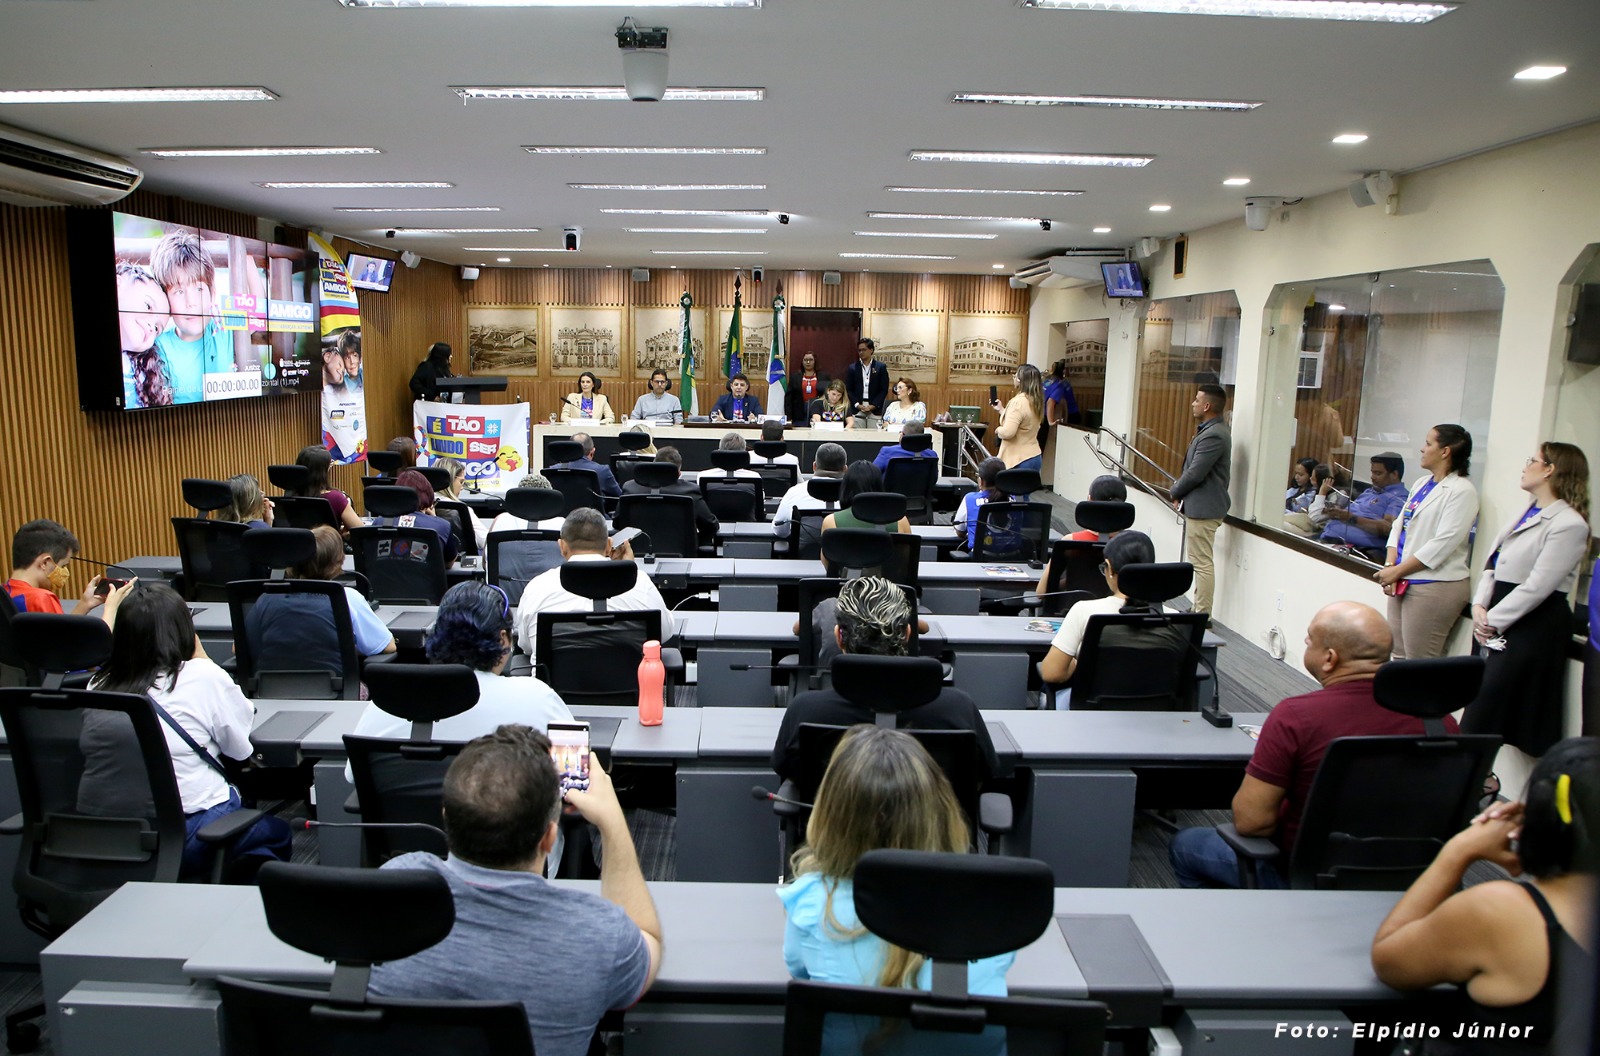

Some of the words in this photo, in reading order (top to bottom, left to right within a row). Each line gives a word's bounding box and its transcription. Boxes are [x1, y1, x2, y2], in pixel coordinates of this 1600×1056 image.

[324, 282, 347, 293] AMIGO
[235, 293, 254, 307] TÃO
[270, 303, 311, 319] AMIGO
[207, 378, 258, 394] 00:00:00.00
[433, 418, 442, 433] É
[448, 415, 480, 432] TÃO
[431, 439, 463, 455] LINDO
[469, 441, 497, 455] SER
